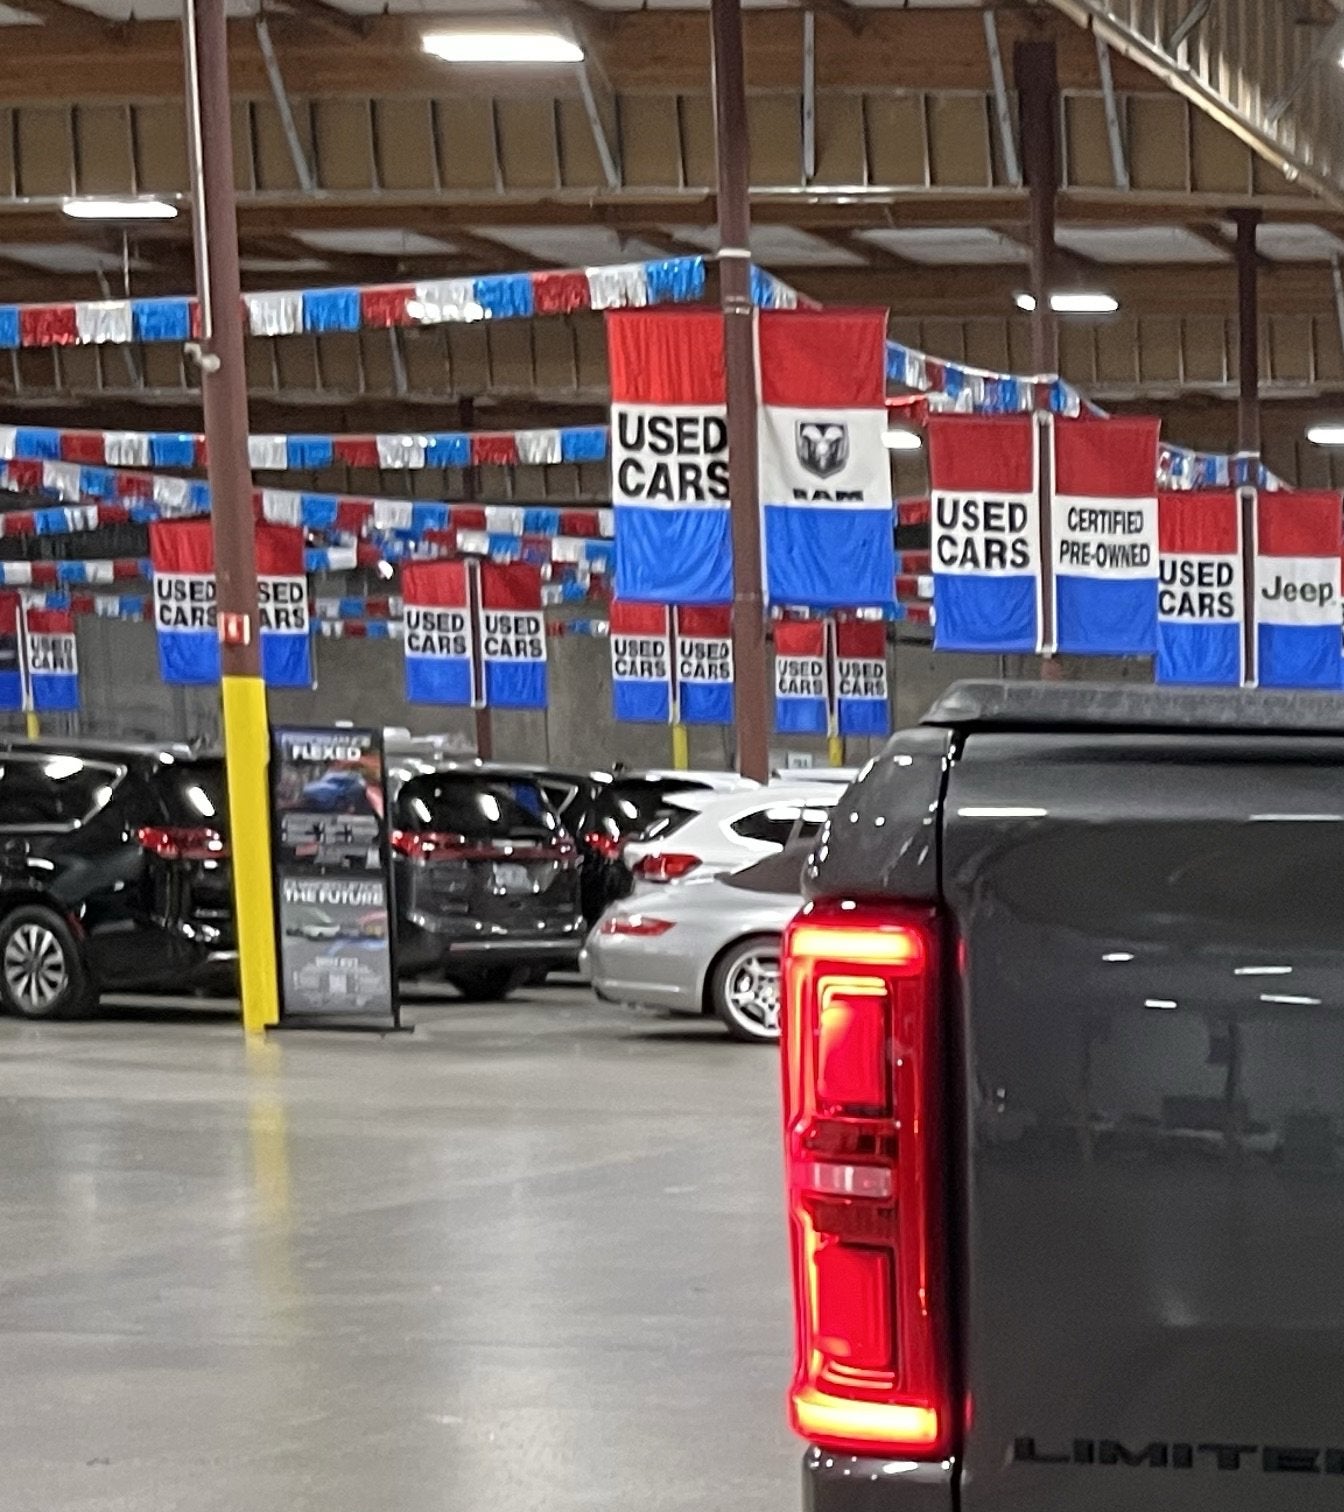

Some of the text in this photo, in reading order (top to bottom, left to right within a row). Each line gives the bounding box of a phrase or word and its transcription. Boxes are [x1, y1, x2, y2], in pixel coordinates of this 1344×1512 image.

[618, 412, 728, 456] USED
[618, 457, 730, 501] CARS
[937, 499, 1027, 532] USED
[1068, 507, 1144, 534] CERTIFIED
[936, 535, 1030, 569] CARS
[1059, 541, 1151, 568] PRE-OWNED
[1159, 560, 1234, 588] USED
[158, 579, 217, 601] USED
[258, 582, 304, 604] SED
[1261, 576, 1334, 606] Jeep
[159, 604, 217, 627] CARS
[1159, 591, 1235, 618] CARS
[260, 607, 305, 629] ARS
[407, 610, 464, 632] USED
[485, 615, 540, 635] USED
[408, 633, 466, 654] CARS
[485, 637, 542, 658] CARS
[614, 638, 665, 657] USED
[680, 640, 728, 659] USED
[615, 659, 666, 678] CARS
[680, 660, 730, 679] CARS
[778, 659, 822, 678] USED
[839, 660, 884, 678] USED
[779, 679, 823, 694] CARS
[839, 679, 885, 696] CARS
